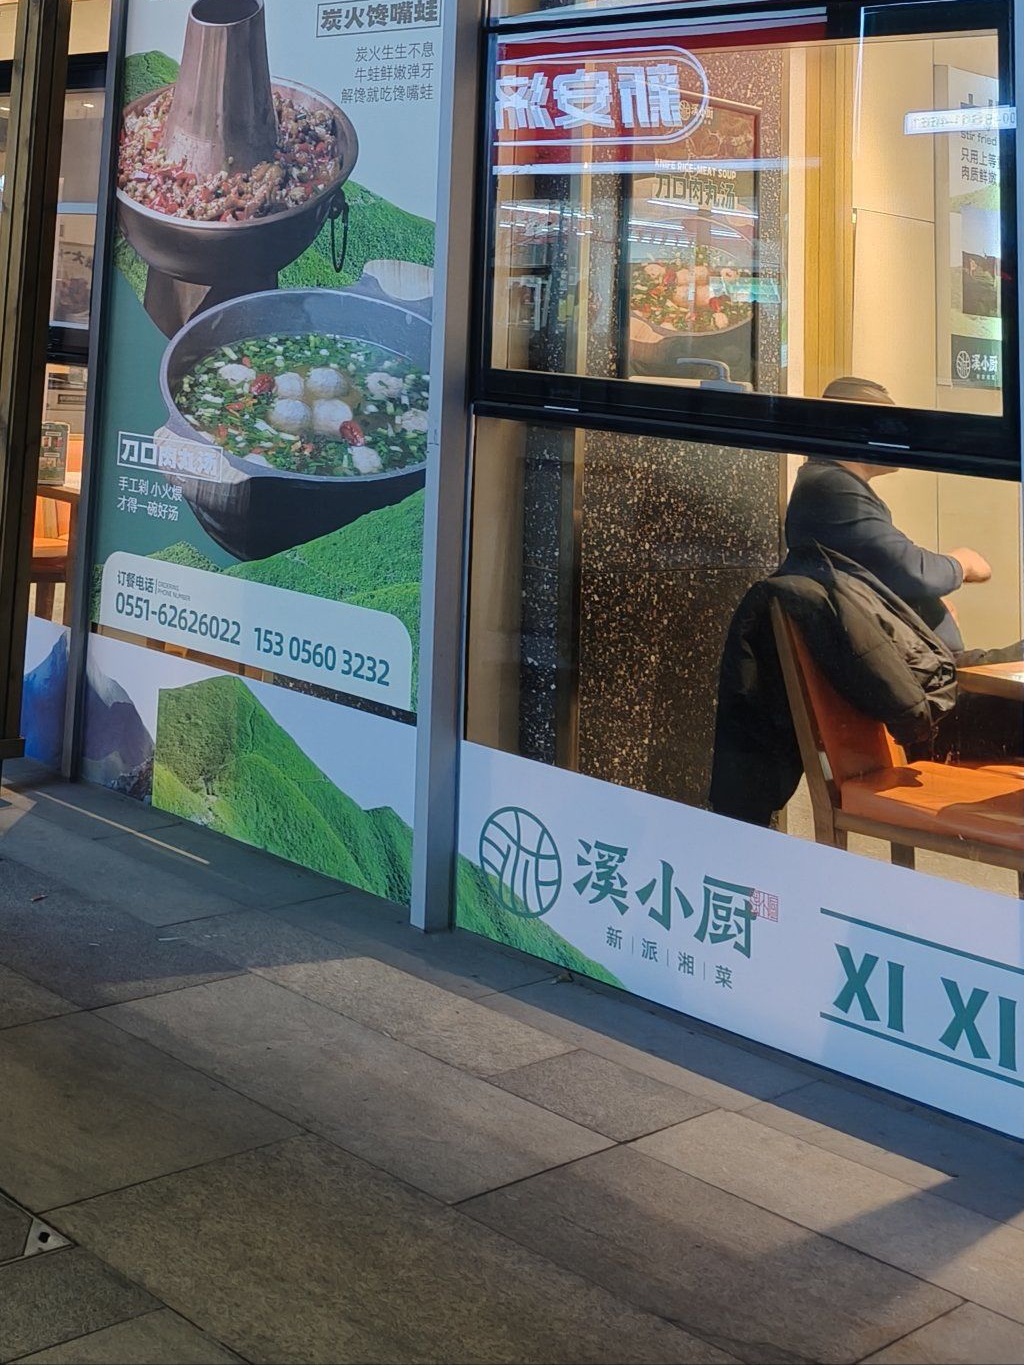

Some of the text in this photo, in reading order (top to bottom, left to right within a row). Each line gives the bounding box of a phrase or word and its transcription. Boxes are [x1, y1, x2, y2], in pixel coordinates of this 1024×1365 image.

[355, 41, 435, 63] 炭火生生不息
[354, 62, 434, 83] 牛蛙鲜嫩弹牙
[341, 83, 434, 104] 解馋就吃馋嘴蛙
[718, 169, 736, 180] SOUP
[656, 174, 735, 209] 刀口肉丸汤
[116, 495, 179, 522] 才得一碗好汤
[117, 570, 154, 594] 订餐电话
[115, 592, 390, 687] 0551-62626022 153 0560 3232
[573, 838, 758, 959] 溪小厨
[832, 943, 1017, 1072] XI XI
